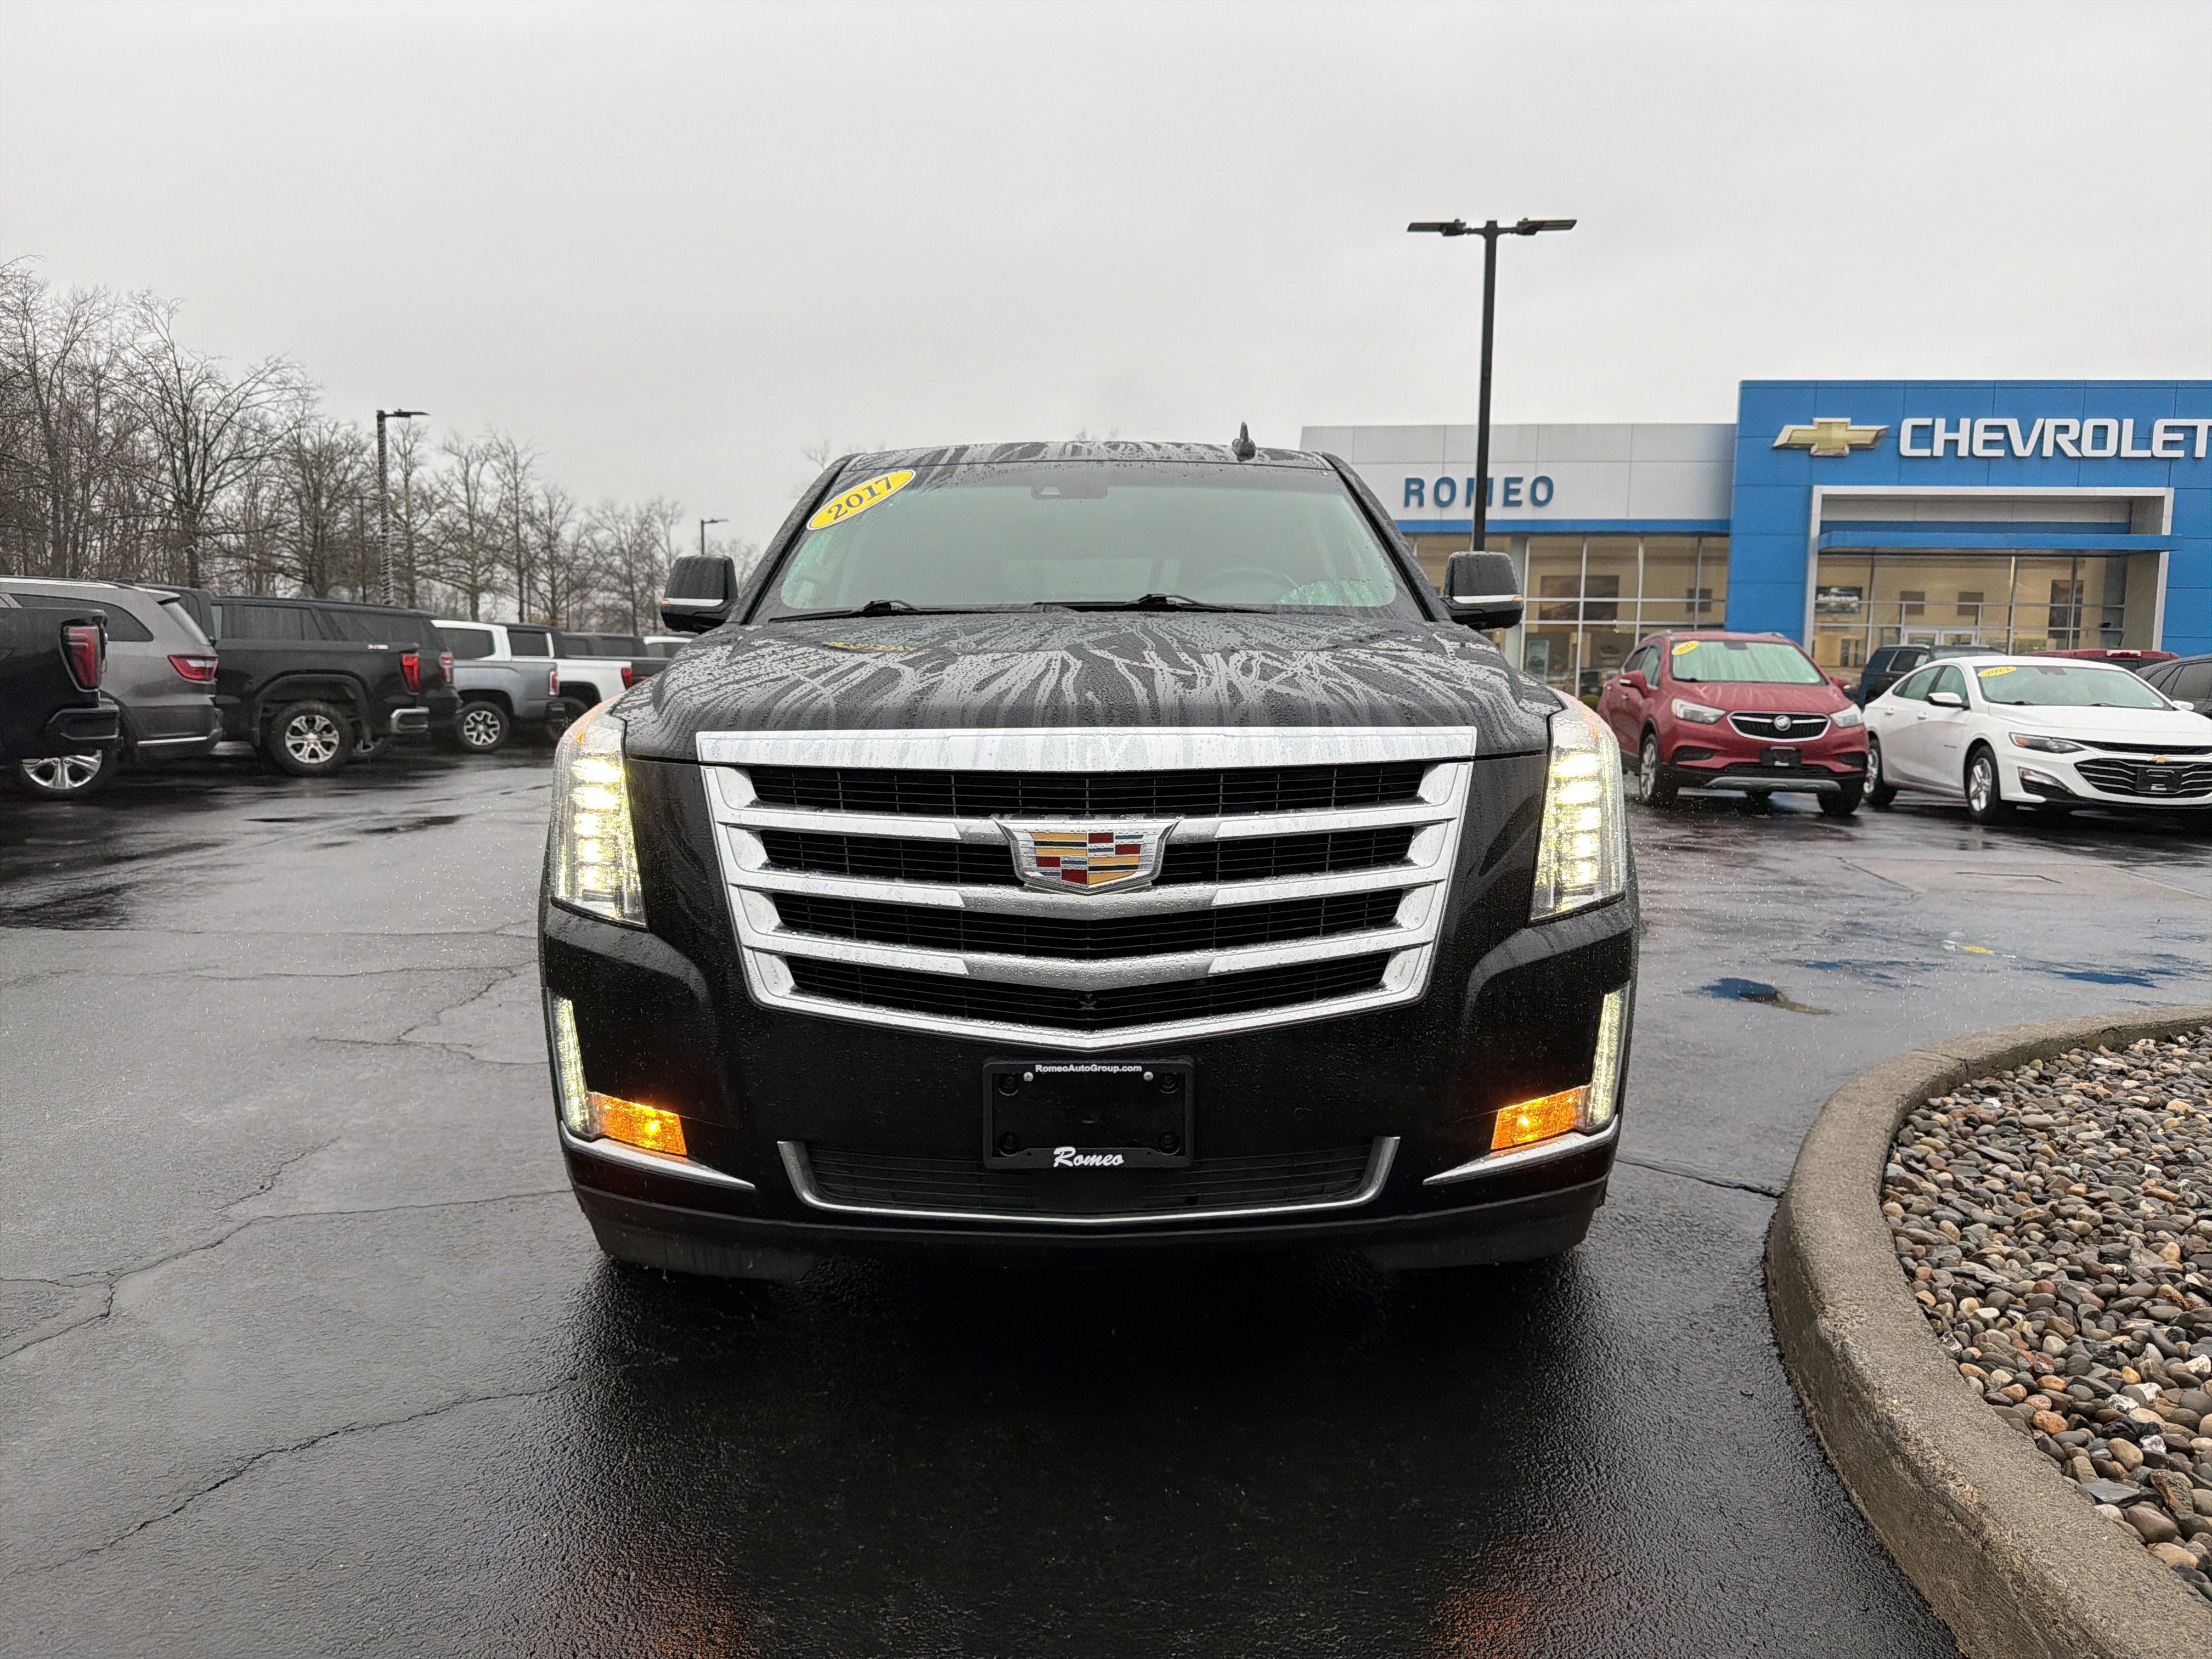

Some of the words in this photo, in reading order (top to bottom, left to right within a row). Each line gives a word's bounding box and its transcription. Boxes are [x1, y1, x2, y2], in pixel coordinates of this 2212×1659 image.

[828, 476, 893, 520] 2017
[1035, 1064, 1142, 1073] RomeoAutoGroup.com
[1053, 1147, 1124, 1167] Romeo
